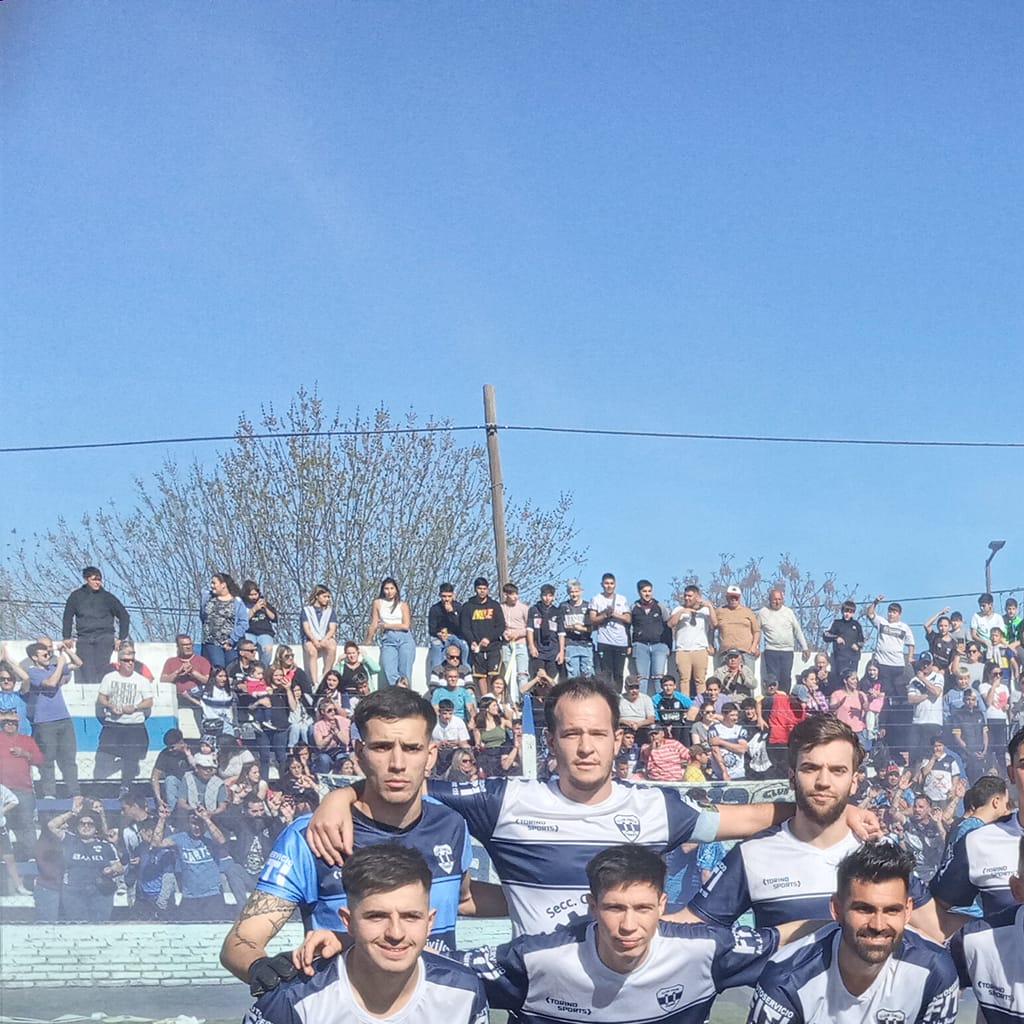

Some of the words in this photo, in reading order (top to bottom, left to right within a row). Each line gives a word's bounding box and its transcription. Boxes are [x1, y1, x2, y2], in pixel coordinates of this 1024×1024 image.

[546, 894, 577, 919] Secc.
[550, 998, 578, 1008] TORINO
[557, 1005, 587, 1015] SPORTS
